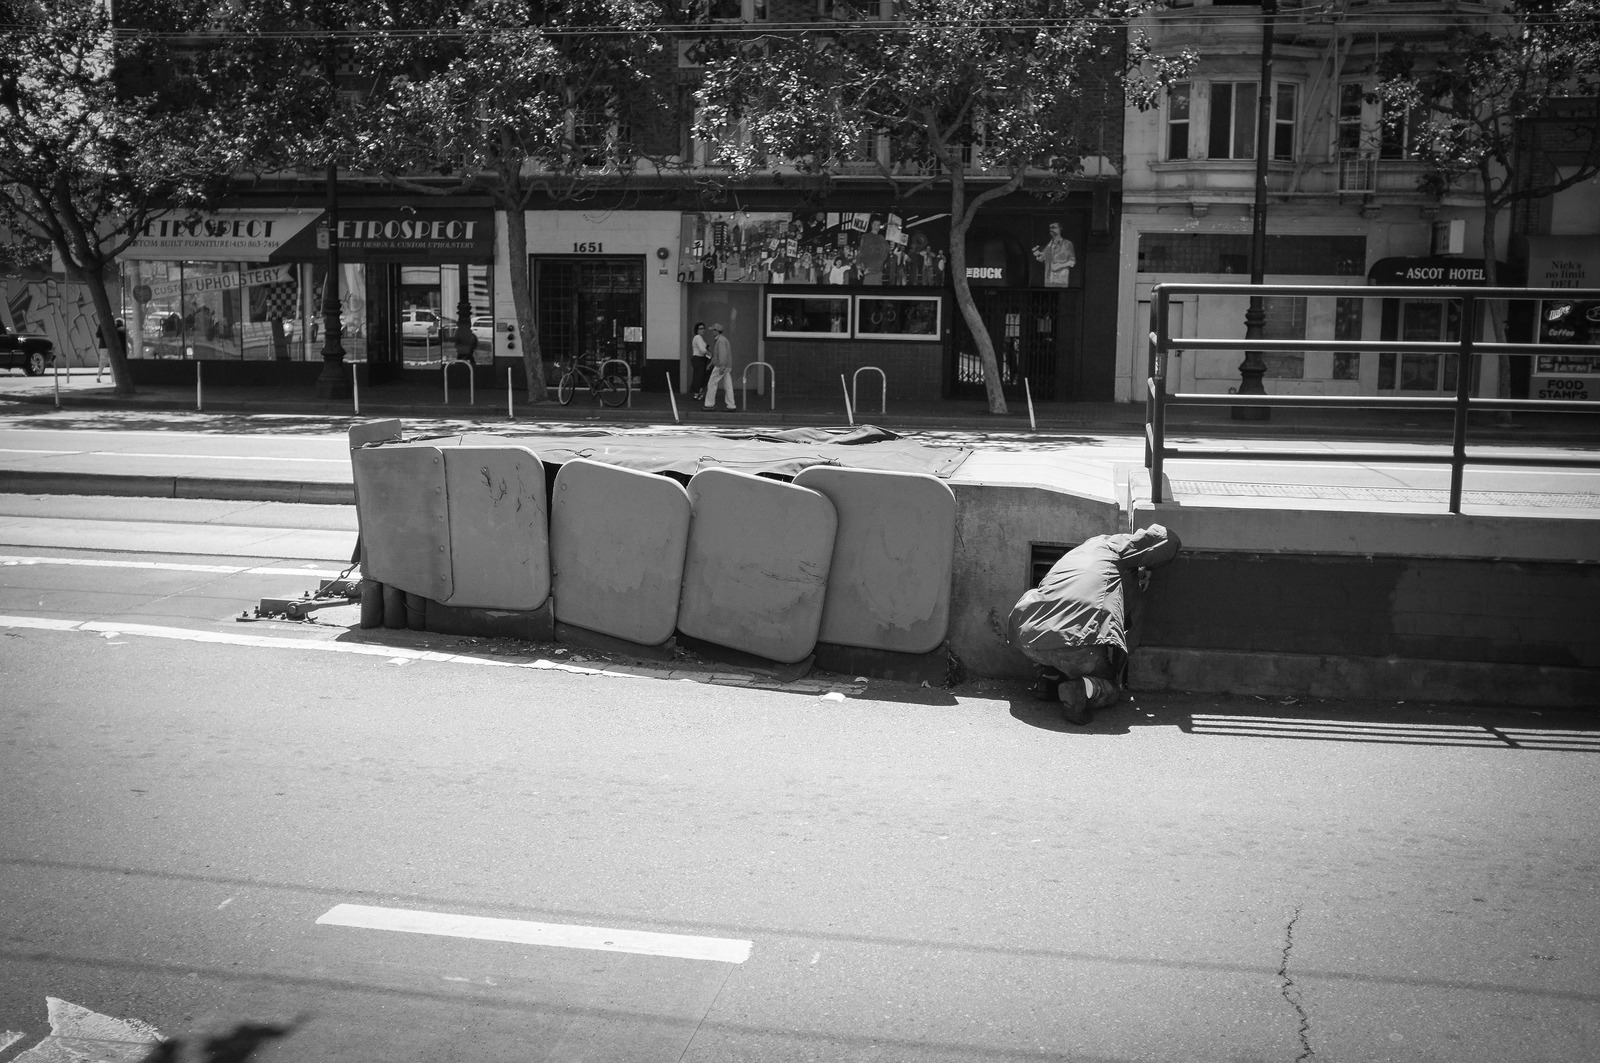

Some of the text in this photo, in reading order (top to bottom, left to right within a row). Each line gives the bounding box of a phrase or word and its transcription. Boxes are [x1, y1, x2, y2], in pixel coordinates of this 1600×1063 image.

[128, 219, 276, 238] ETROSPECT
[337, 220, 478, 239] ETROSPECT
[160, 240, 183, 248] BUILT
[184, 240, 230, 248] FURNITURE
[229, 240, 247, 249] (415)
[247, 240, 280, 248] 863-7414
[427, 241, 475, 249] UPHOLSTERY
[572, 242, 603, 253] 1651
[1551, 260, 1582, 270] Nick's
[972, 267, 1002, 279] BUCK
[1406, 267, 1486, 280] ASCOT HOTEL
[1561, 269, 1585, 279] limit
[195, 267, 281, 292] UPHOLSTERY
[1548, 328, 1575, 337] Coffee
[1547, 379, 1584, 390] FOOD
[1538, 389, 1589, 400] STAMPS
